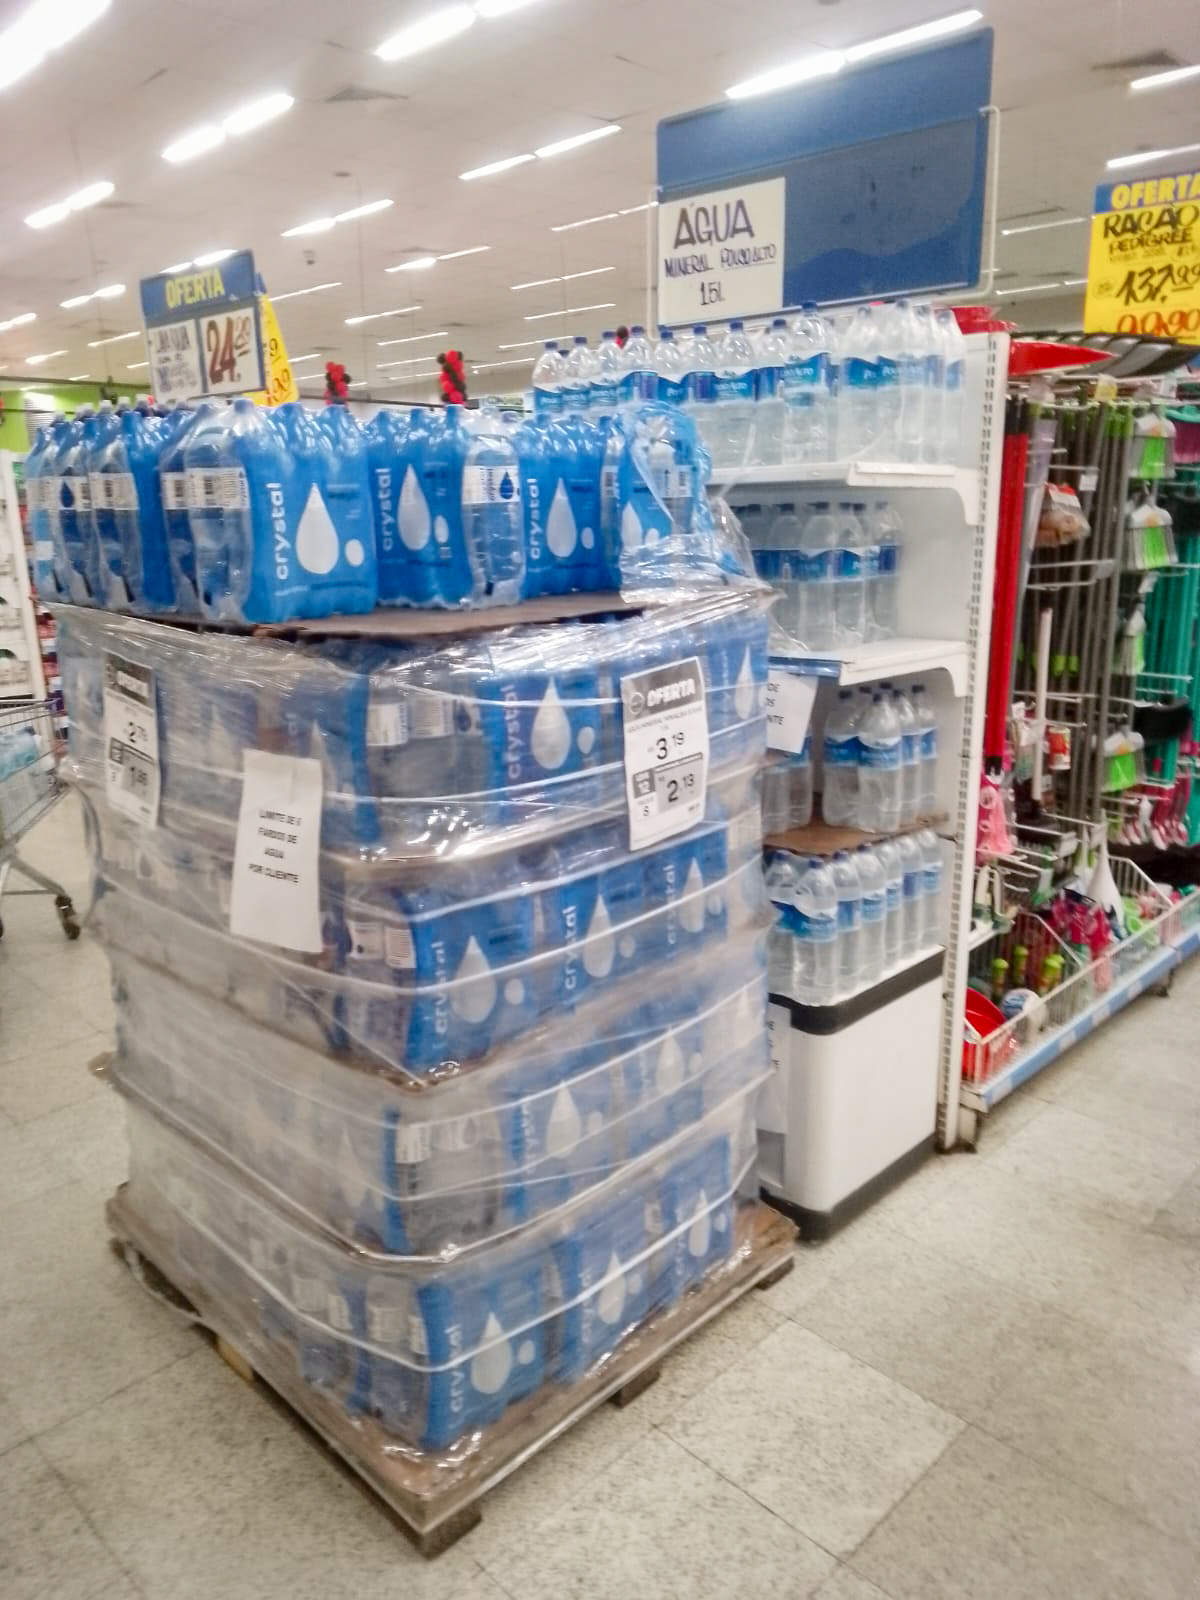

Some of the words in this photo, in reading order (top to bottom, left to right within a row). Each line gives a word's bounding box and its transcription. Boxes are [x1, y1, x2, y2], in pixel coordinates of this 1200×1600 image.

[165, 268, 225, 310] OFERTA
[266, 482, 292, 580] crystal
[375, 467, 396, 551] crystal
[527, 478, 543, 560] crystal
[500, 684, 525, 779] crystal
[647, 678, 697, 707] OFERTA
[444, 1323, 465, 1413] crytal
